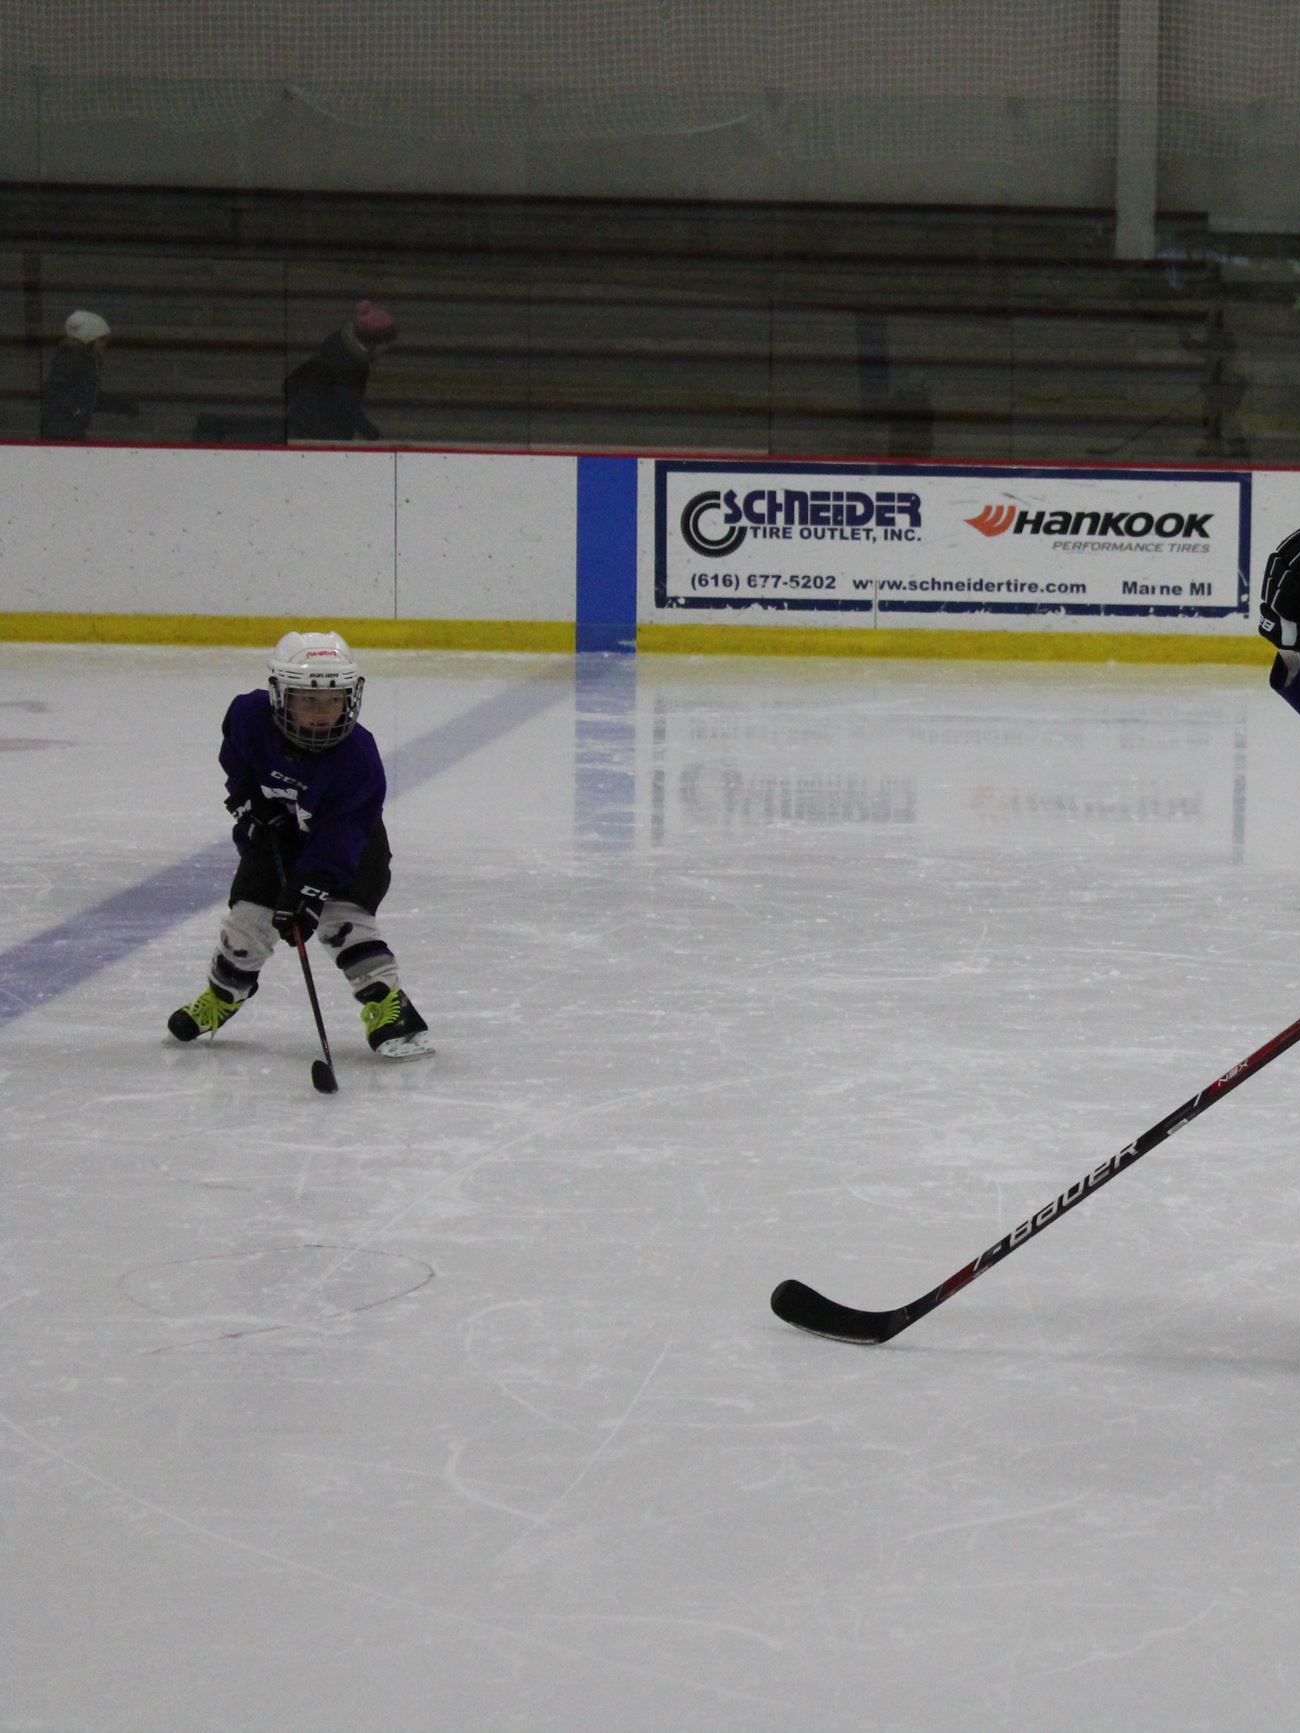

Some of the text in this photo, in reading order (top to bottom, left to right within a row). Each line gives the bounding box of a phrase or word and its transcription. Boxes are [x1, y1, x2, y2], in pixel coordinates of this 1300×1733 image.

[722, 488, 922, 528] SCHNEIDER
[749, 525, 922, 544] TIRE OUTLET, INC.
[1052, 540, 1211, 554] PERFORMANCE TIRES
[690, 573, 740, 592] (616)
[746, 574, 836, 590] 677-5202
[852, 577, 1087, 595] www.schneidertire.com
[1189, 582, 1213, 597] MI
